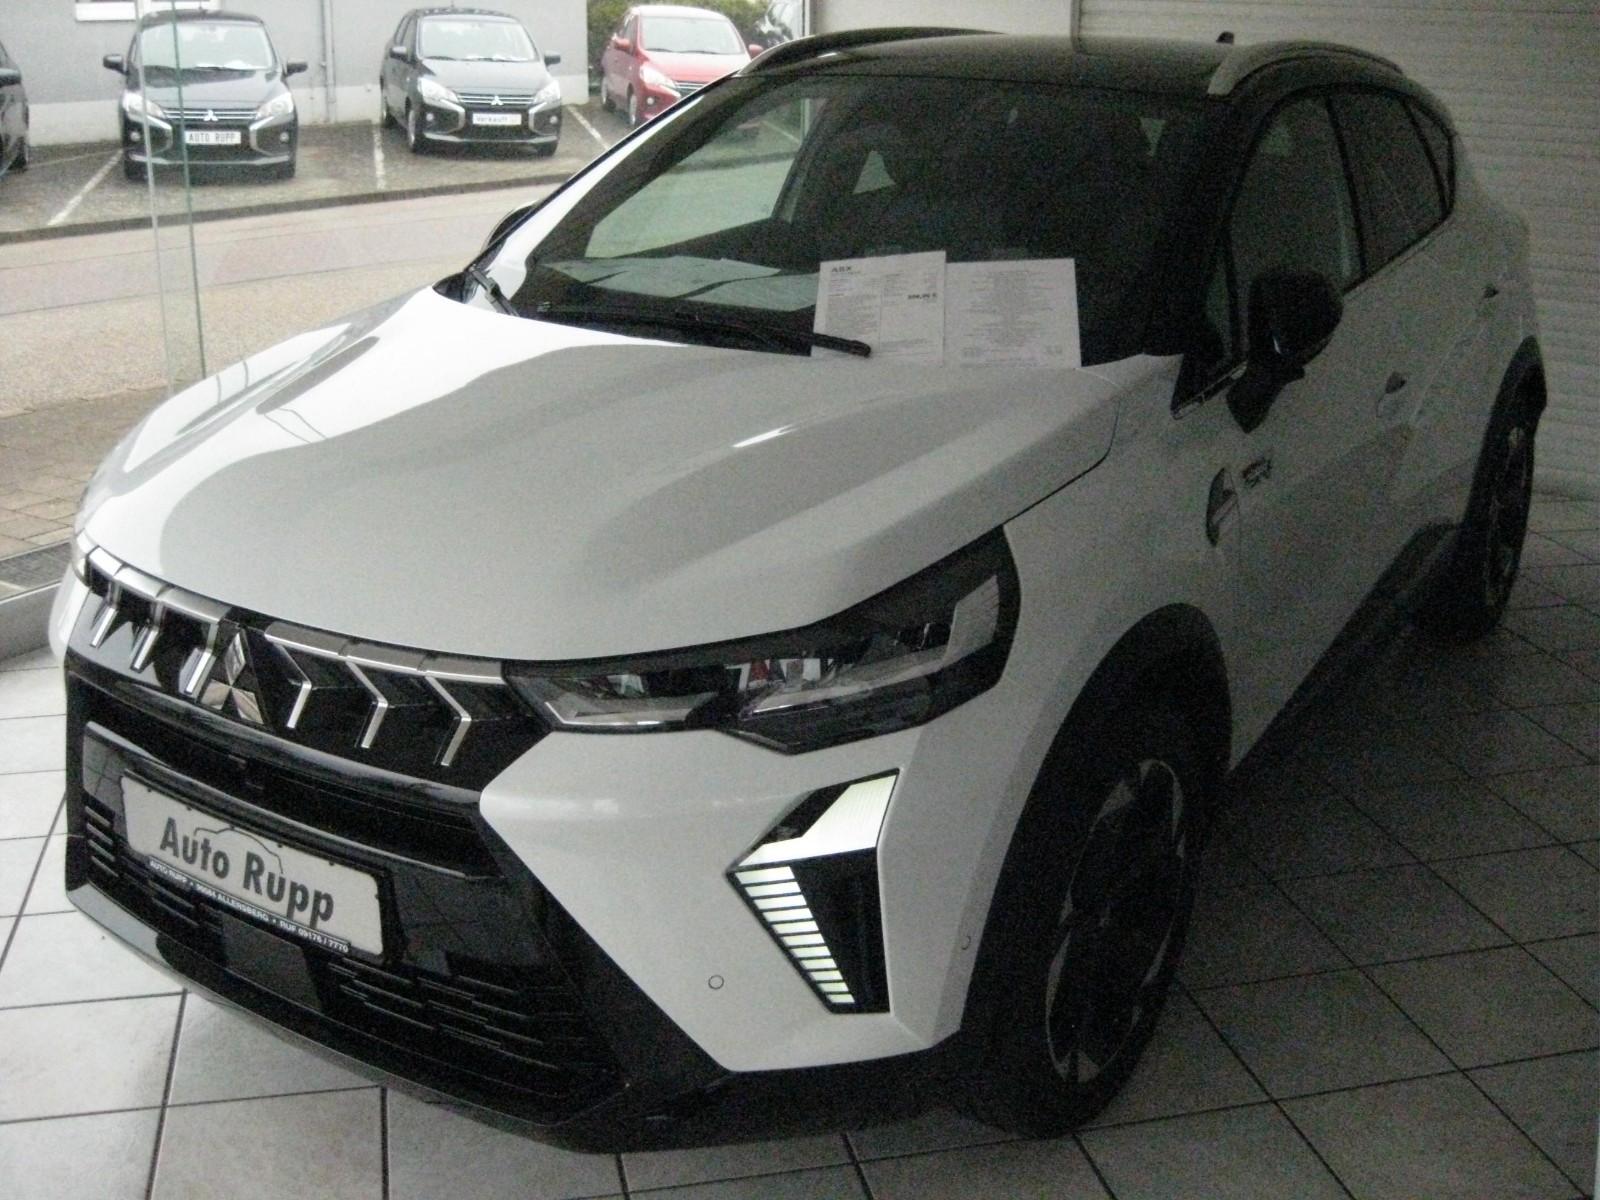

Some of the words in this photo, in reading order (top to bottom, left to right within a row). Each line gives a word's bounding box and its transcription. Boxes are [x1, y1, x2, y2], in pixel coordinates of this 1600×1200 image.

[188, 132, 209, 142] AUTO
[215, 132, 235, 142] RUPP
[160, 817, 229, 879] Auto
[243, 851, 334, 929] Rupp
[217, 892, 270, 922] ALLERSBERG
[280, 920, 297, 933] RUF
[328, 940, 350, 954] 7770
